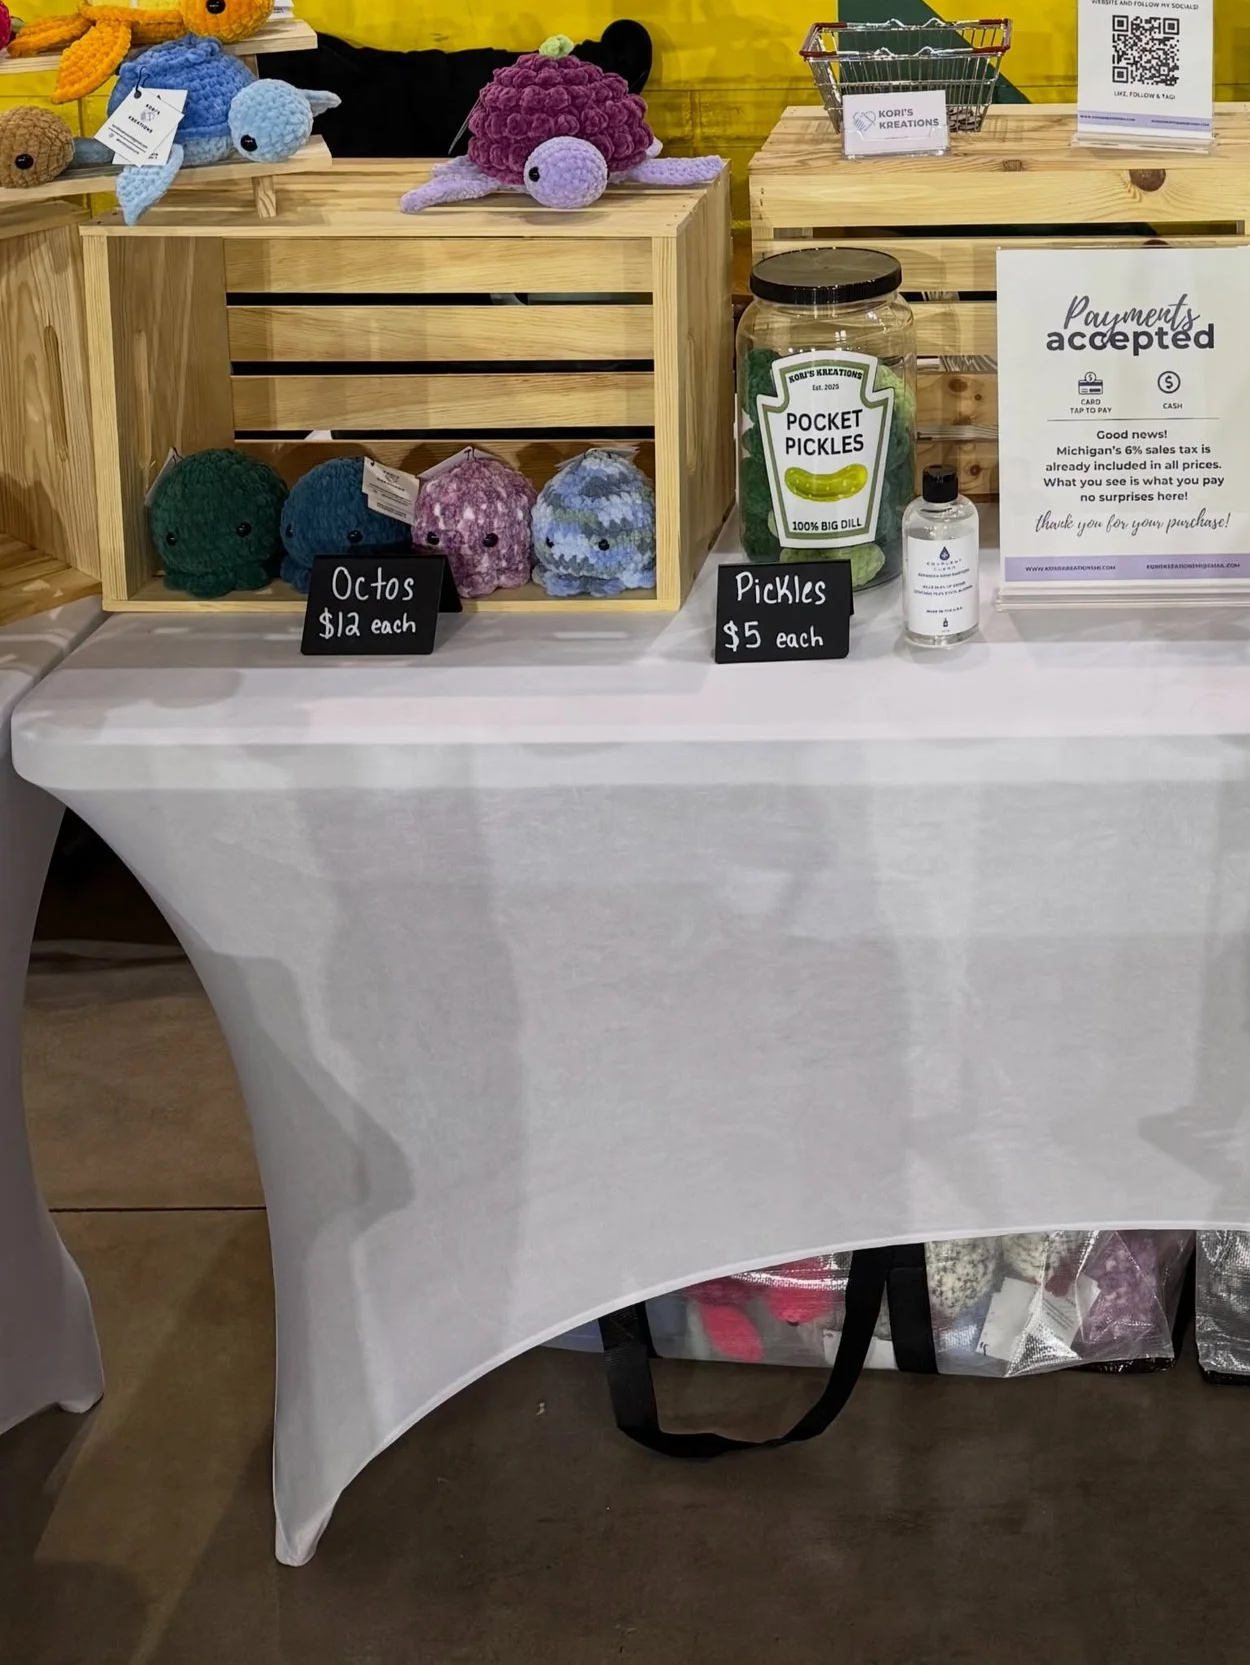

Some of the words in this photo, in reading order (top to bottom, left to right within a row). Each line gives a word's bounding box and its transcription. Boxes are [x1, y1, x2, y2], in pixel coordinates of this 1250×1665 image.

[1134, 0, 1159, 8] FOLLOW
[879, 109, 913, 118] KORI'S
[880, 118, 939, 129] KREATIONS
[1063, 293, 1200, 346] Payments
[1046, 323, 1214, 356] accepted
[789, 370, 815, 383] KORI'S
[816, 369, 863, 380] KREATIONS
[787, 409, 863, 431] POCKET
[1096, 430, 1128, 440] Good
[1132, 429, 1168, 439] news!
[785, 434, 864, 456] PICKLES
[1056, 445, 1122, 457] Michigan's
[1125, 445, 1143, 455] 6%
[1146, 445, 1176, 455] sales
[1179, 446, 1198, 454] tax
[1201, 444, 1211, 454] is
[1045, 462, 1090, 473] already
[1094, 460, 1147, 471] included
[1150, 460, 1162, 470] in
[1165, 460, 1179, 470] all
[1182, 459, 1222, 471] prices.
[1043, 477, 1076, 487] What
[1080, 478, 1102, 488] you
[1106, 478, 1126, 486] see
[1130, 476, 1139, 486] is
[1142, 476, 1173, 486] what
[1176, 477, 1199, 487] you
[1203, 477, 1225, 487] pay
[1080, 494, 1096, 502] no
[1099, 492, 1154, 503] surprises
[1157, 491, 1188, 501] here!
[792, 521, 819, 532] 100%
[821, 520, 838, 531] BIG
[841, 518, 862, 529] DILL
[1035, 510, 1074, 532] thank
[1077, 520, 1102, 537] you
[1106, 513, 1128, 533] for
[1131, 520, 1163, 536] your
[1166, 507, 1231, 534] purchase!
[332, 566, 414, 601] Octos
[735, 571, 827, 605] Pickles
[319, 607, 360, 639] $12
[371, 613, 416, 634] each
[723, 620, 762, 653] $5
[776, 625, 824, 649] each
